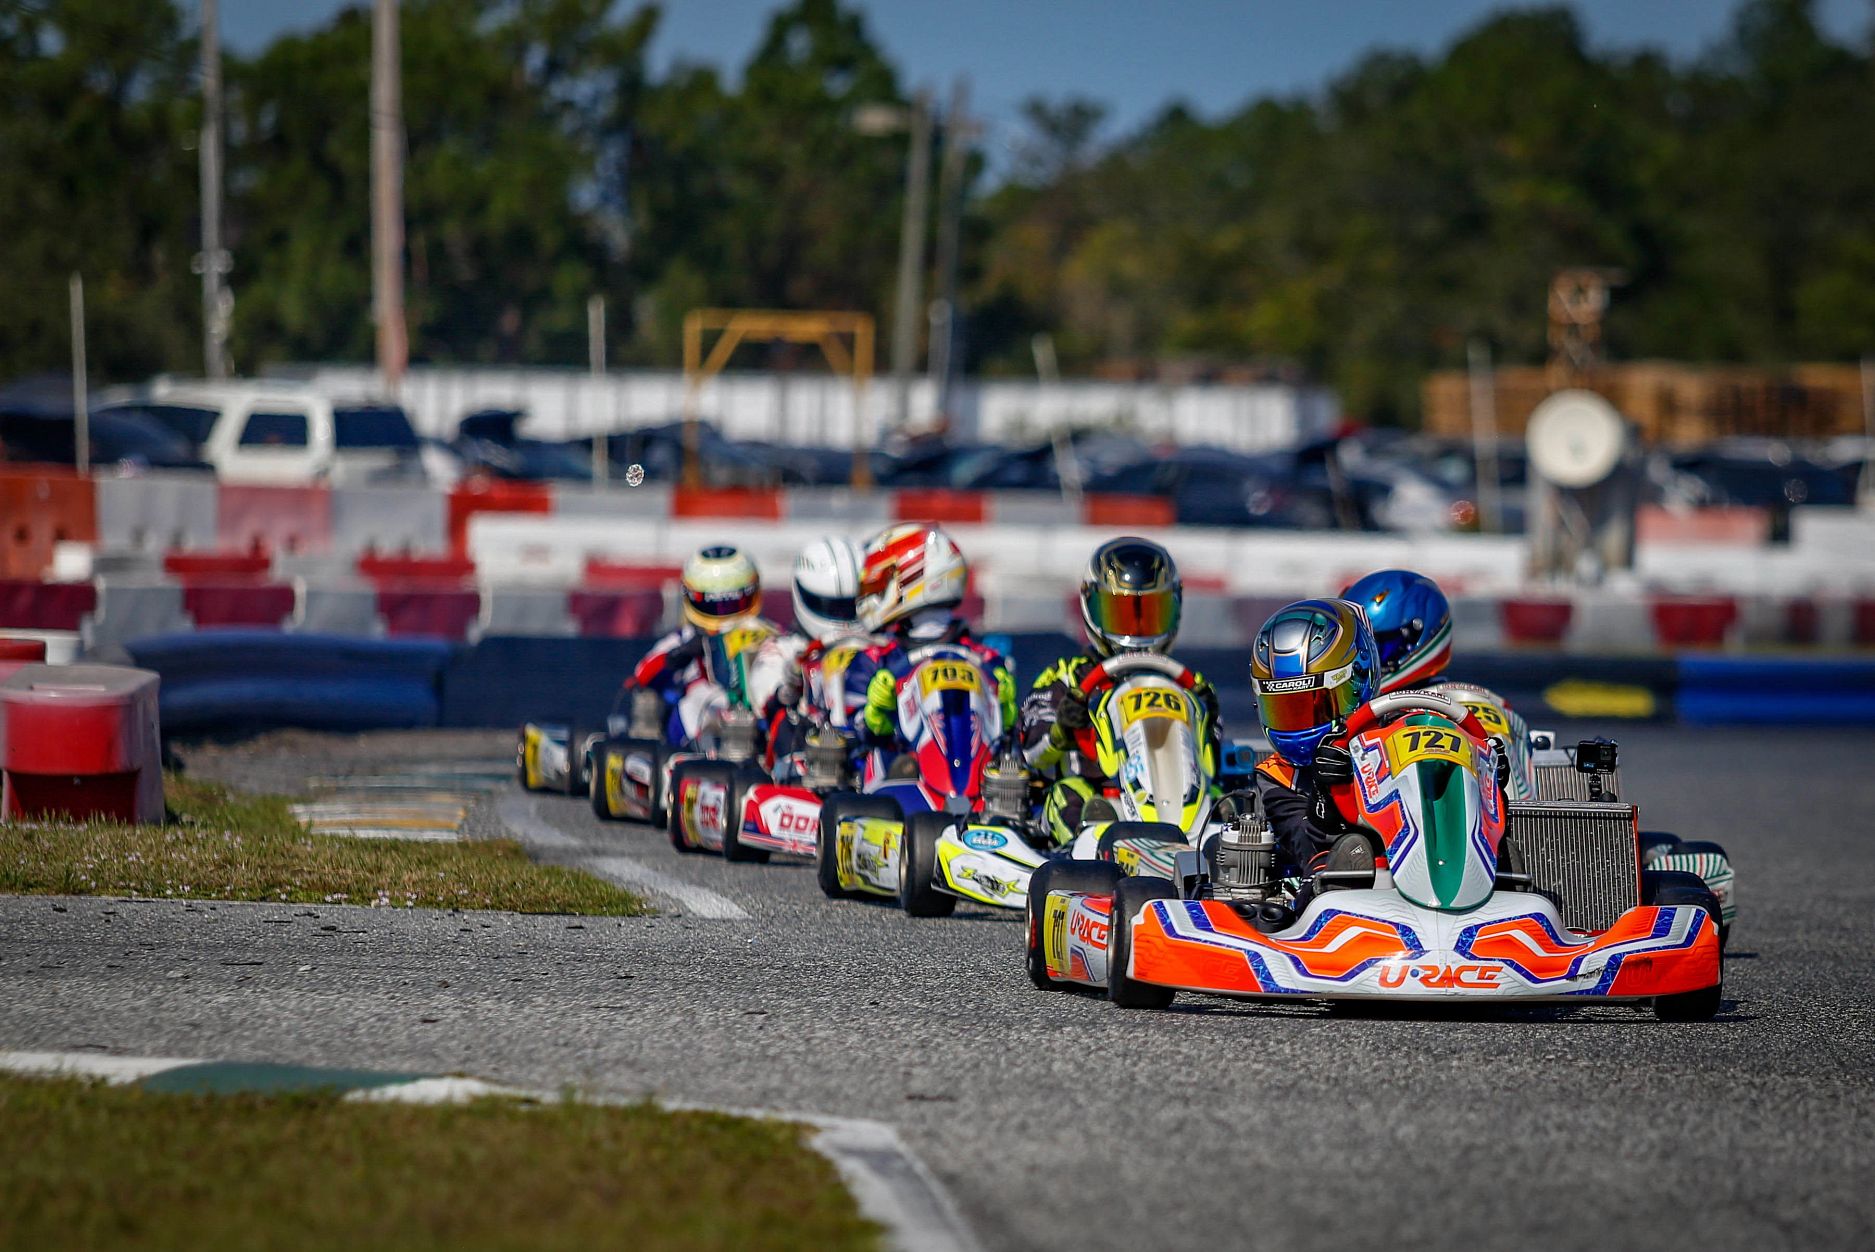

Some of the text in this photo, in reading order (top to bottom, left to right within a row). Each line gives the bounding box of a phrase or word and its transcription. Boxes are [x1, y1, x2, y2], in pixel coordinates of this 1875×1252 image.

[1275, 679, 1311, 689] CAROLI
[1127, 691, 1182, 712] 726
[1466, 704, 1502, 725] 25
